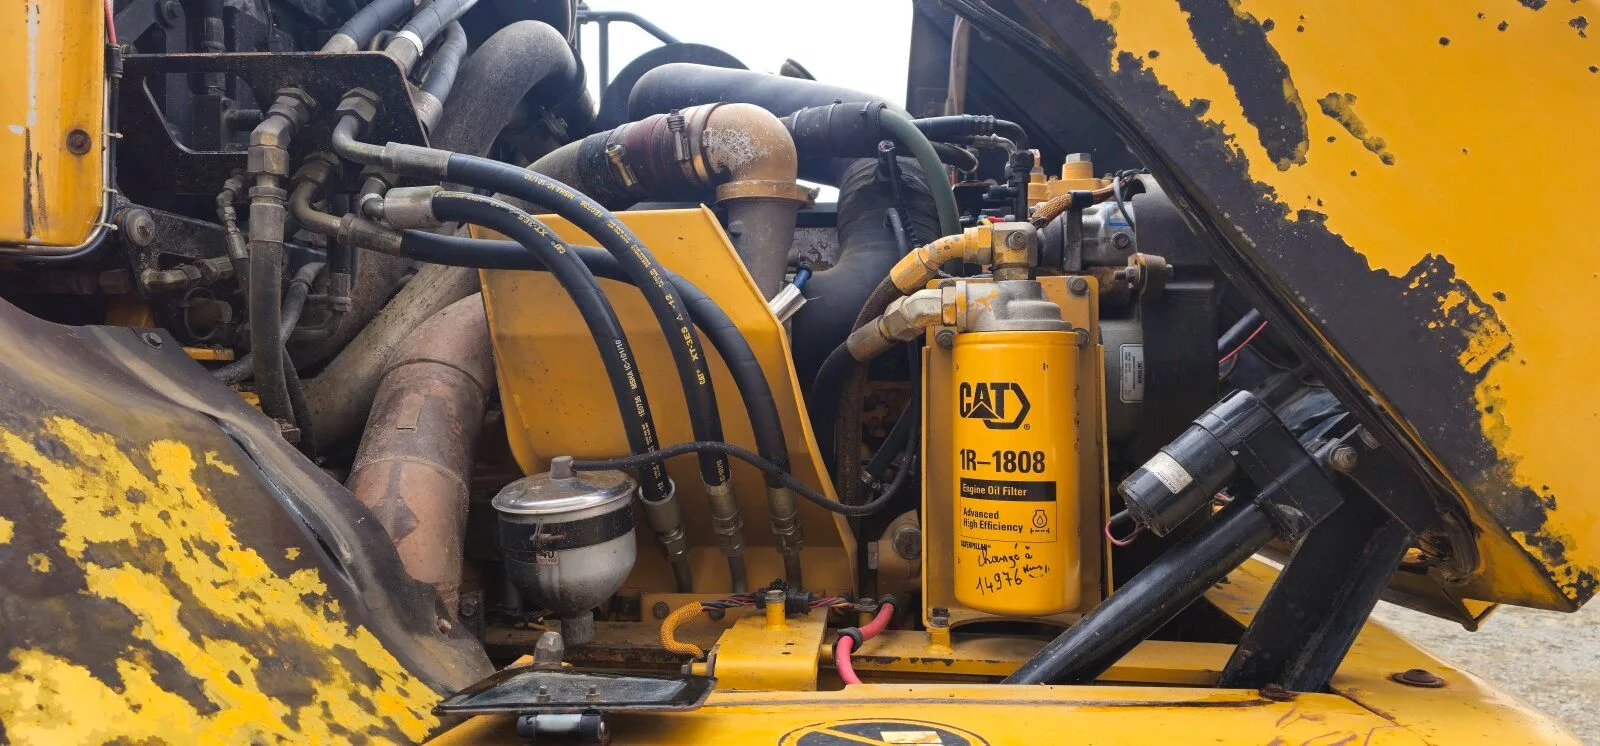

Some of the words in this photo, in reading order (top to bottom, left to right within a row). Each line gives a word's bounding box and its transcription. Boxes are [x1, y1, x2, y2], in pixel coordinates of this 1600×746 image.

[524, 173, 554, 190] IC-101/10
[556, 187, 576, 199] MSHA
[517, 215, 548, 236] XT-3ES
[681, 326, 698, 361] XT-3ES
[615, 339, 631, 371] IC-101/10
[626, 370, 638, 390] MSHA
[635, 395, 646, 417] 1E0736
[960, 382, 1012, 420] CAT
[960, 448, 1046, 474] 1R-1808
[962, 483, 986, 495] Engine
[988, 485, 1001, 495] Oil
[1002, 486, 1028, 496] Filter
[963, 507, 1000, 520] Advanced
[963, 518, 978, 530] High
[979, 520, 1024, 534] Efficiency
[976, 569, 1023, 595] 14976
